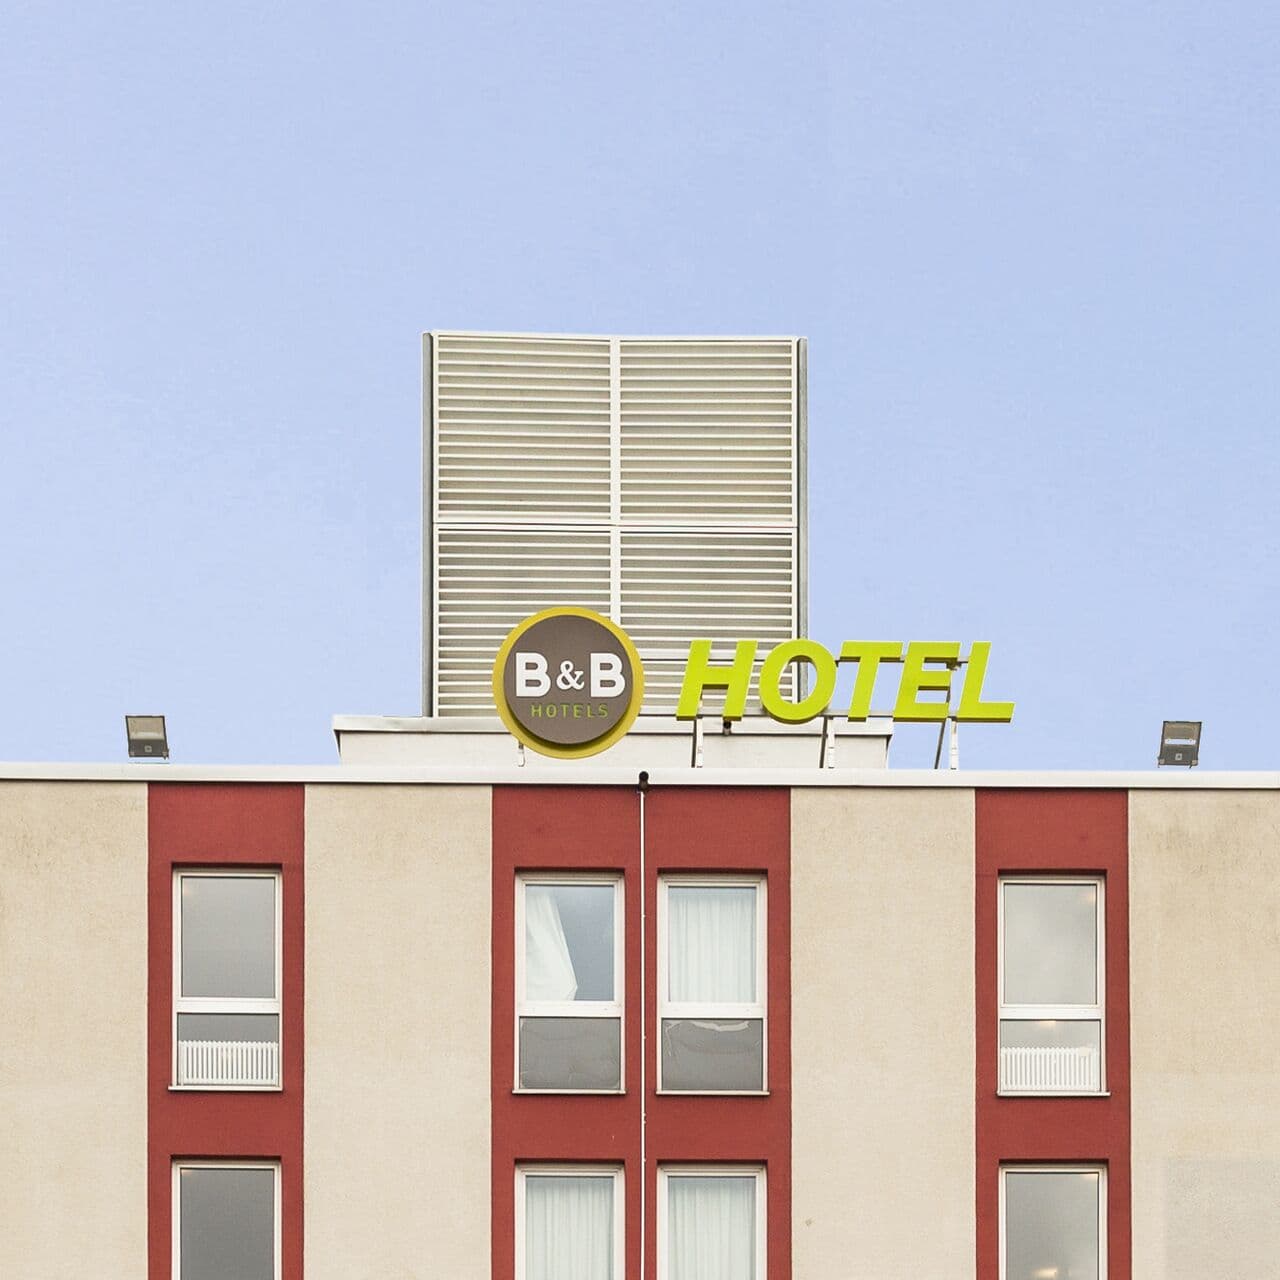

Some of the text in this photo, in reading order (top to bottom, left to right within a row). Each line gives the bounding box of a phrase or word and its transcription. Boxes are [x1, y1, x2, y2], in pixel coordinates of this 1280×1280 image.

[516, 652, 626, 698] B&B
[675, 638, 1016, 724] HOTEL
[530, 703, 609, 718] HOTELS
